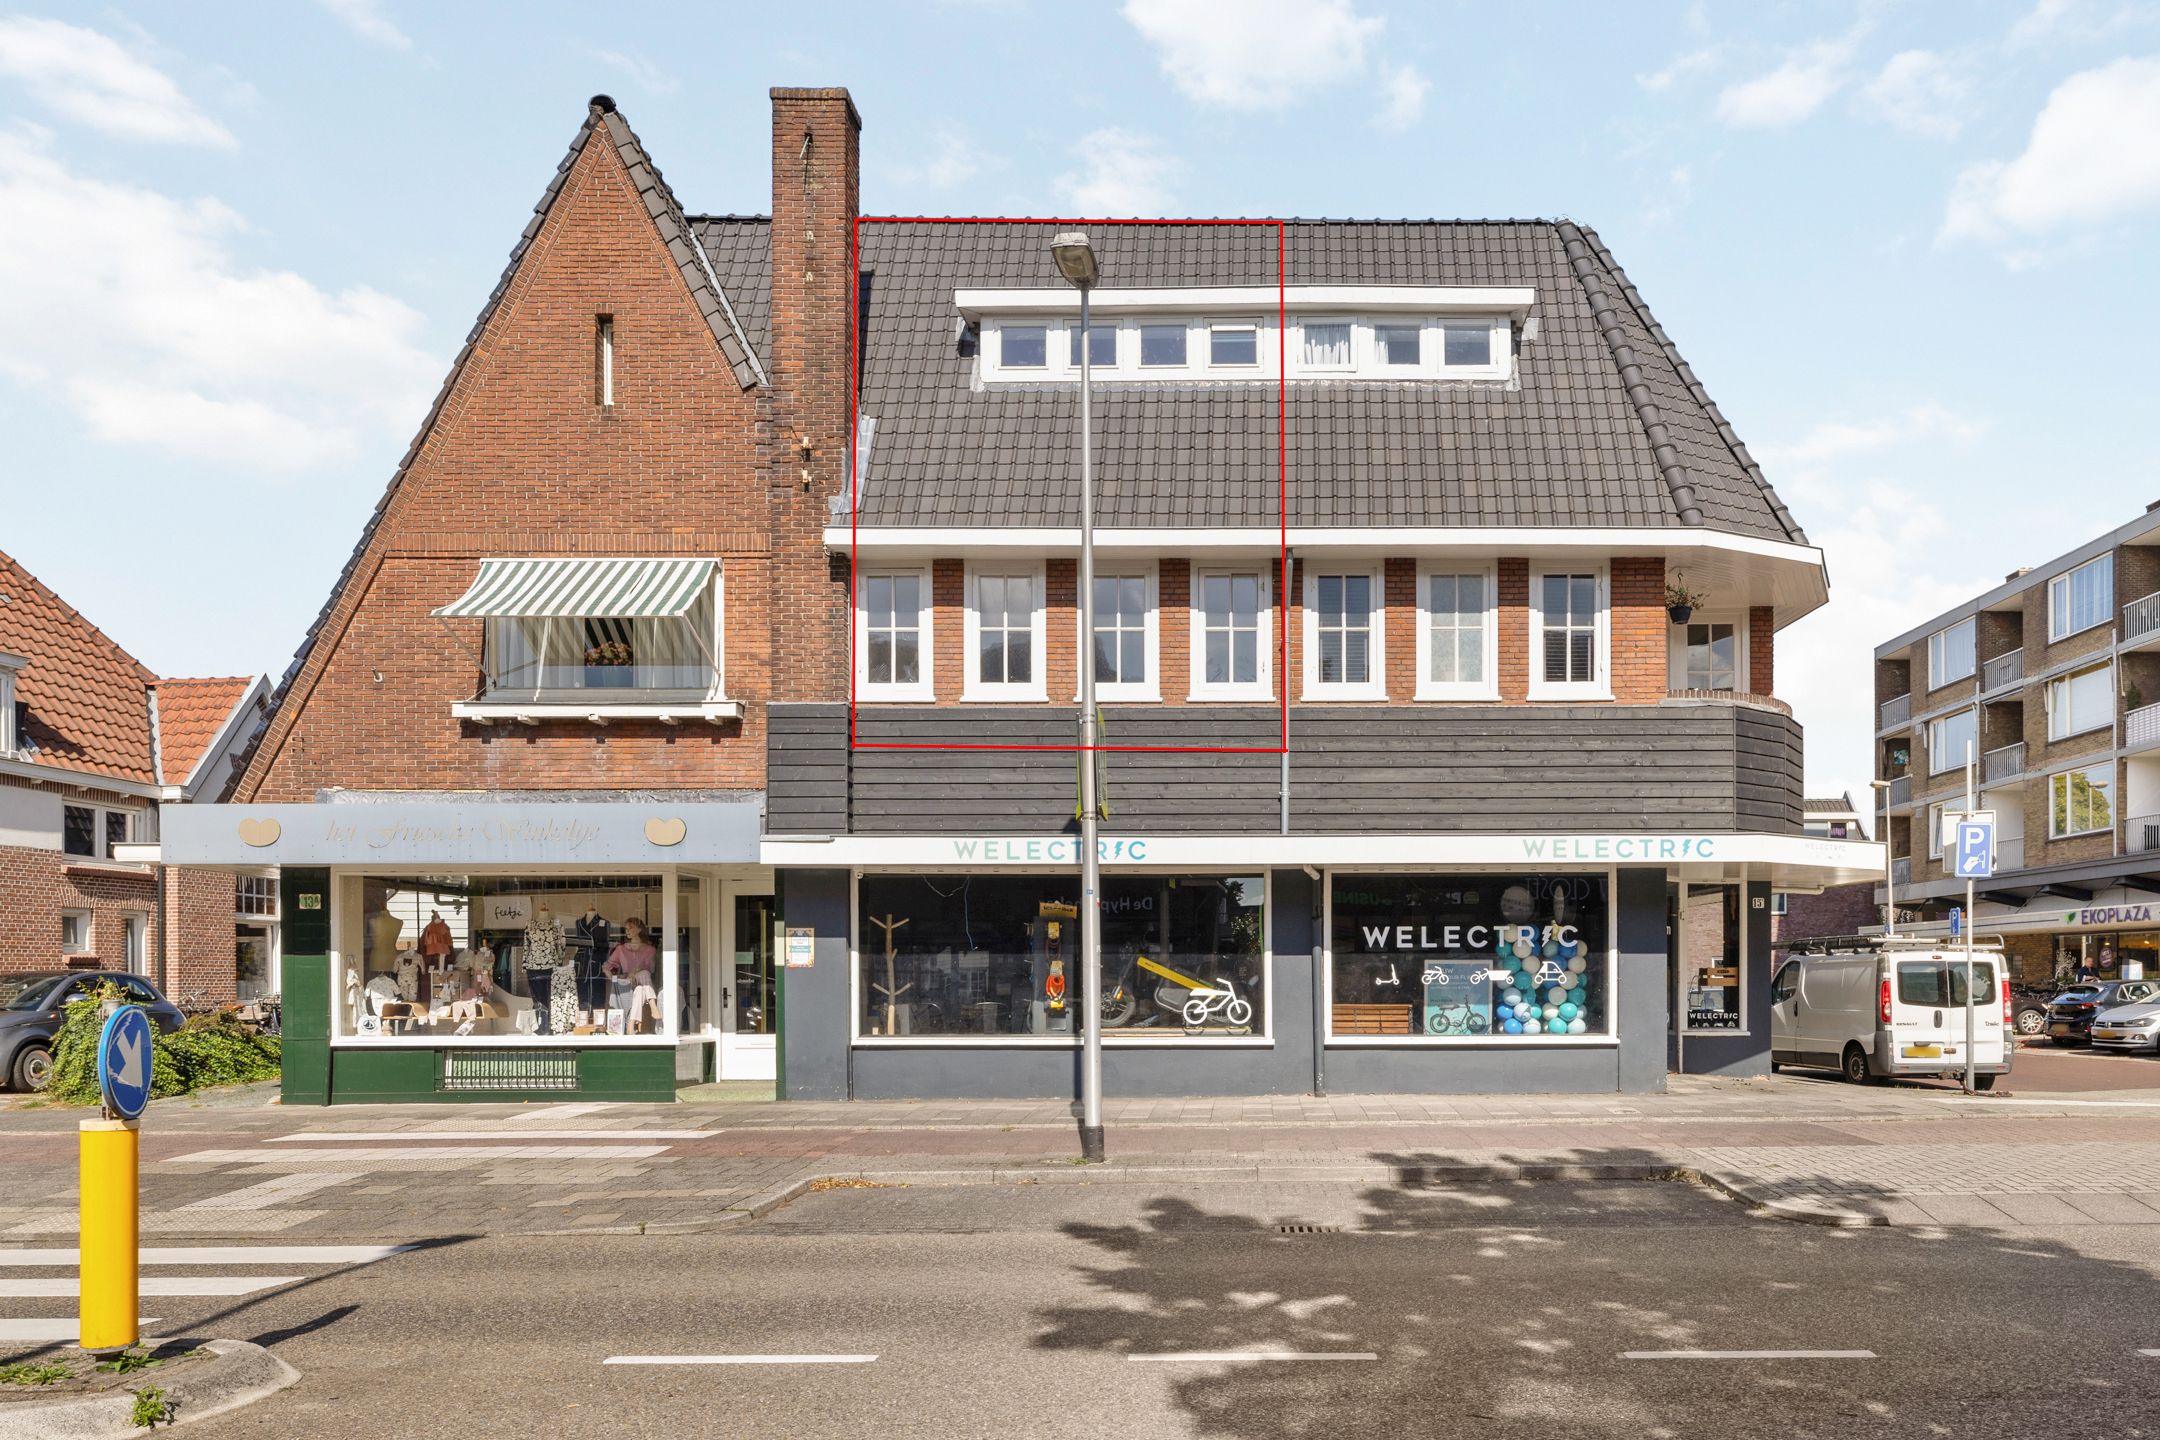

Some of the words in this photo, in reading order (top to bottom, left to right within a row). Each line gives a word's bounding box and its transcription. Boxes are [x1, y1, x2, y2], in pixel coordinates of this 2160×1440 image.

[1522, 839, 1714, 858] WELECTRIC
[1965, 827, 1984, 854] P
[2081, 905, 2151, 925] EKOPLAZA
[1362, 925, 1578, 948] WELECTRIC
[1689, 1012, 1739, 1020] WELECTRIC
